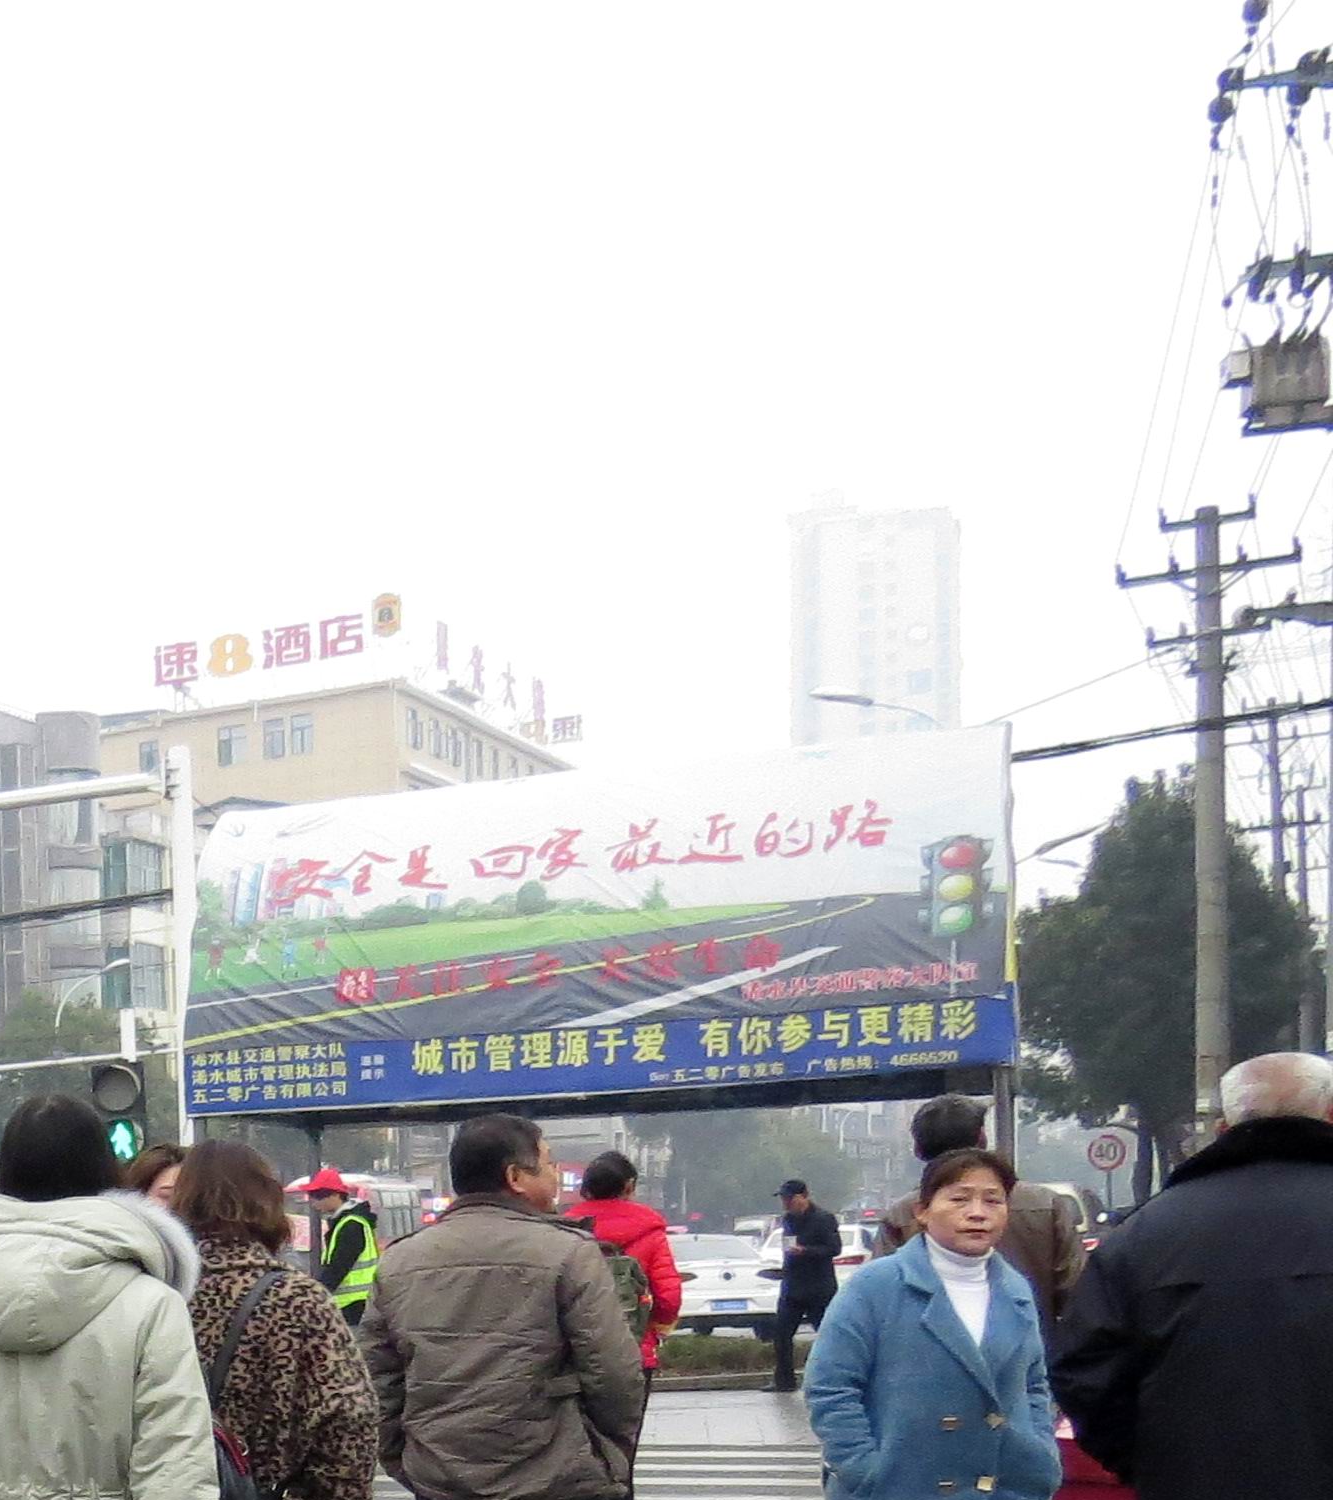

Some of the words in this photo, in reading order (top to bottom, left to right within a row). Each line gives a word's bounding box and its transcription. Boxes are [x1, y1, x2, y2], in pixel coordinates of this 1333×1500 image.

[153, 613, 364, 687] 速8酒店
[412, 1023, 666, 1076] 城市管理源于爱
[699, 999, 978, 1058] 有你参与更精彩
[192, 1081, 347, 1105] 五二零广告有限公司
[1094, 1143, 1118, 1161] 40
